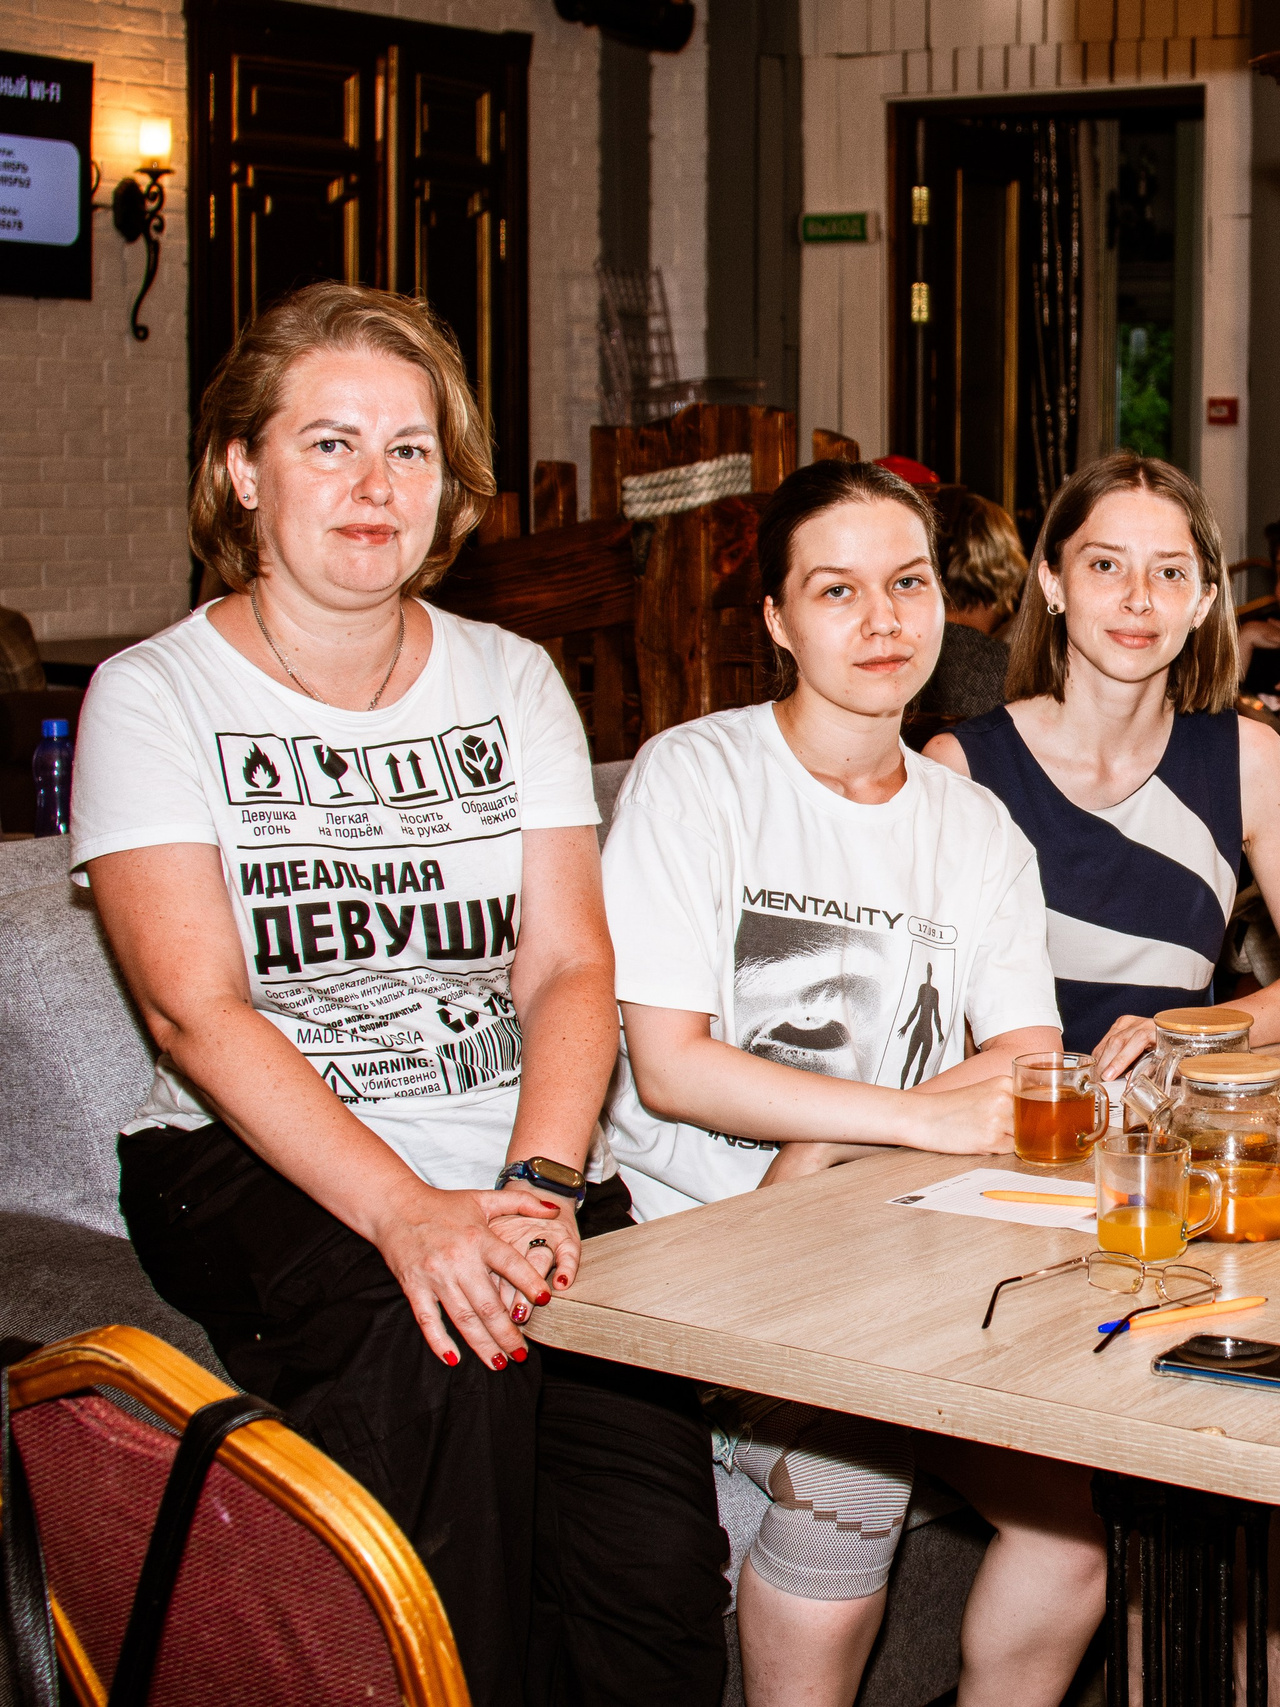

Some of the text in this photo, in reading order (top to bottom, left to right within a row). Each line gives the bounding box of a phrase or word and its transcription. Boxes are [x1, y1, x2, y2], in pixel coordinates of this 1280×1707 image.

[241, 809, 297, 824] Девушка
[325, 812, 369, 825] Легкая
[399, 811, 443, 825] Носить
[480, 808, 517, 825] нежно
[253, 825, 291, 837] огонь
[318, 824, 384, 839] на подъём
[401, 821, 453, 838] на руках
[240, 859, 445, 899] ИДЕАЛЬНАЯ
[742, 885, 904, 929] MENTALITY
[265, 987, 306, 1000] Состав:
[297, 1028, 345, 1044] MADE
[352, 1057, 435, 1077] WARNING:
[361, 1070, 437, 1094] убийственно
[394, 1082, 442, 1098] красива
